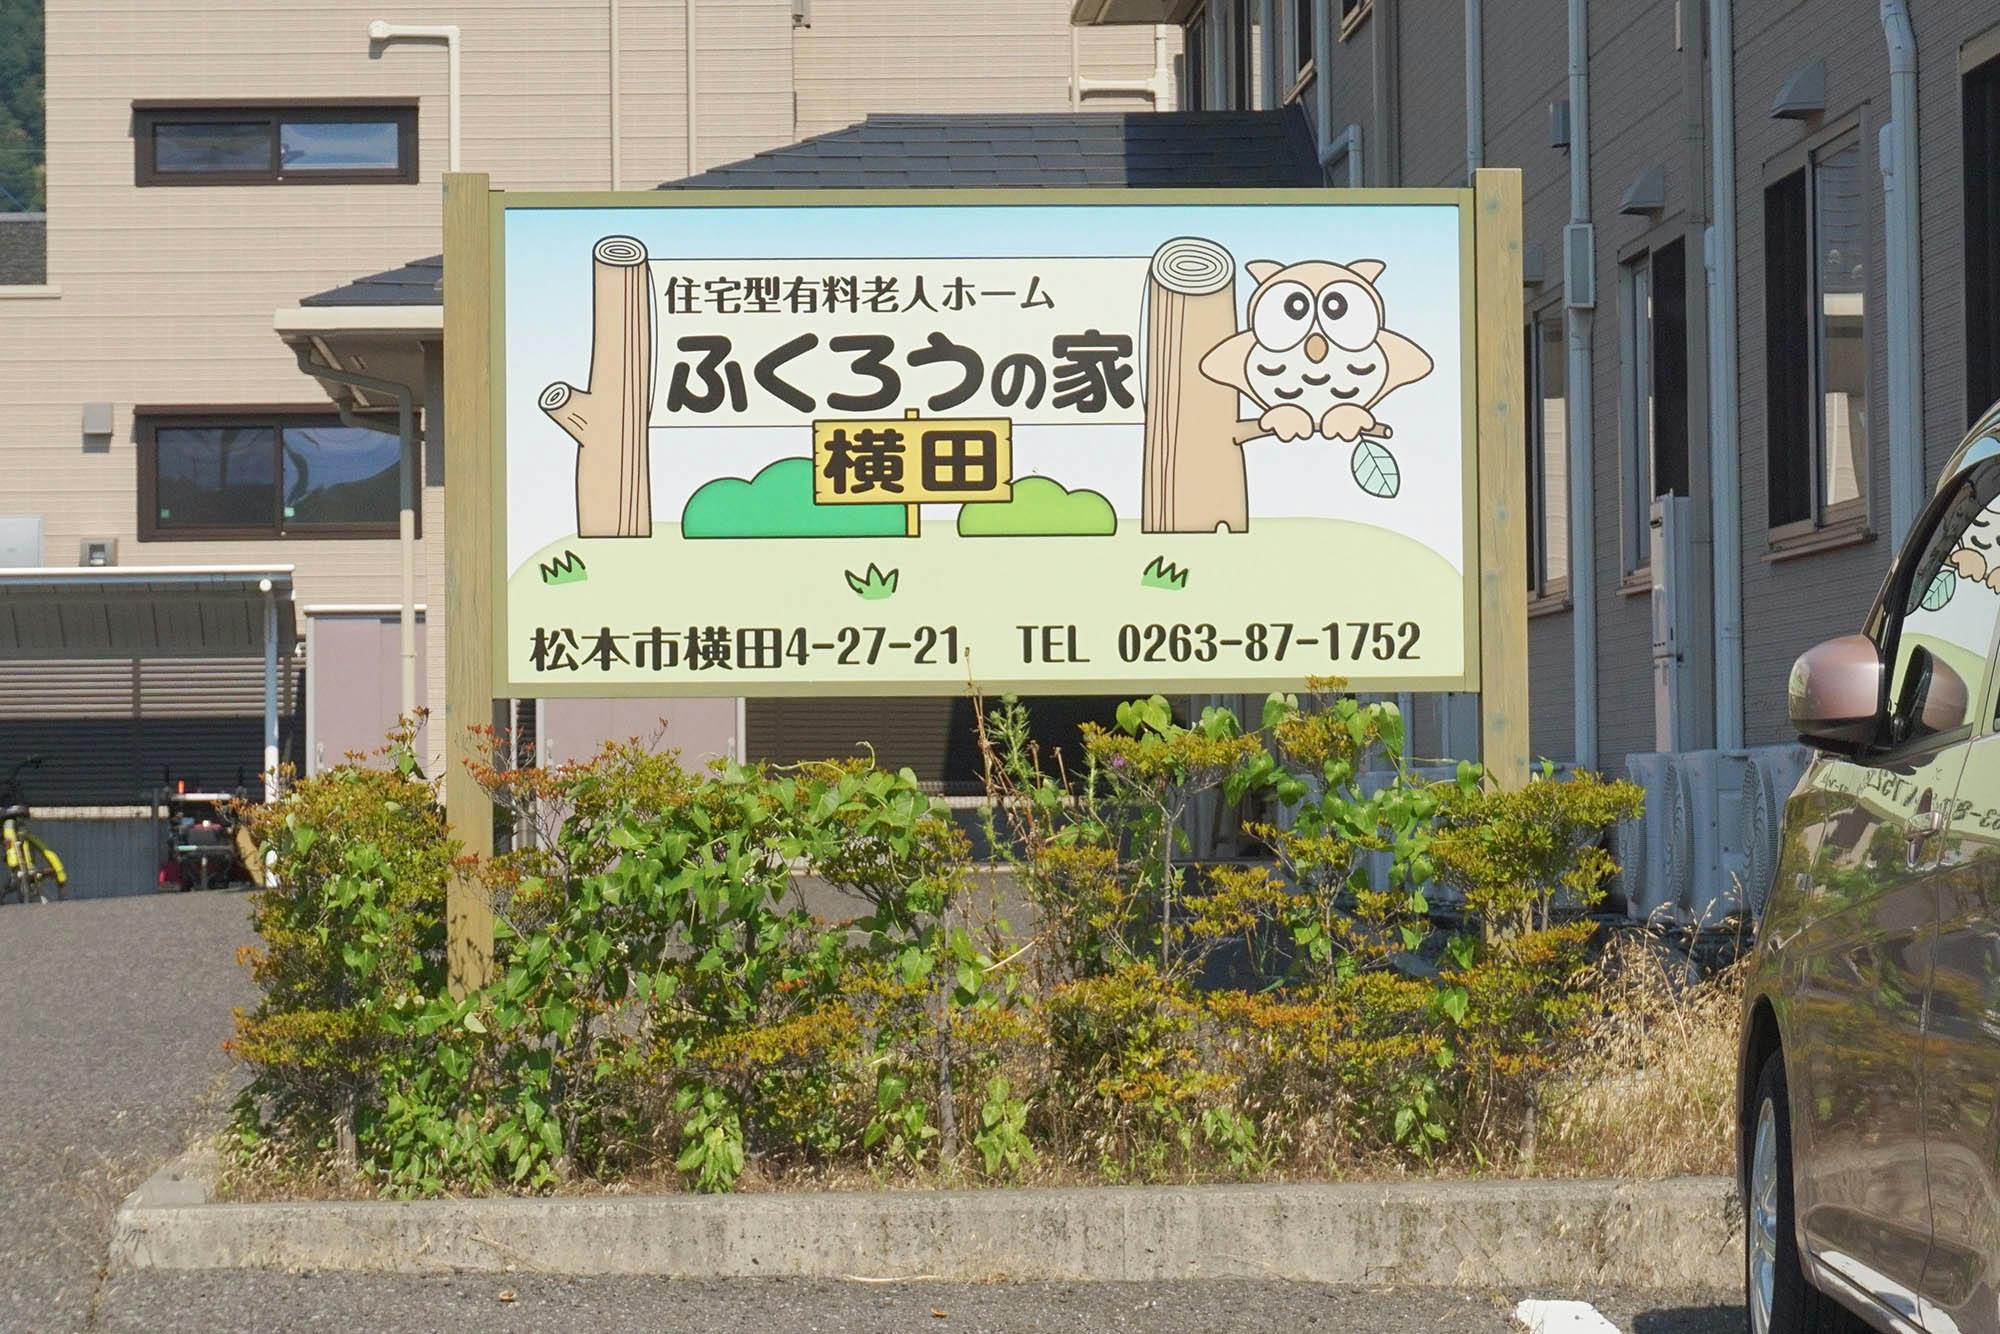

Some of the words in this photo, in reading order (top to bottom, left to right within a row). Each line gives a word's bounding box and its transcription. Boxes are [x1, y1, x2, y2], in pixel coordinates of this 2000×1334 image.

[664, 276, 1056, 314] 住宅型有料老人ホーム
[667, 329, 1135, 414] ふくろうの家
[823, 428, 998, 495] 横田
[1016, 624, 1090, 664] TEL
[1118, 621, 1421, 663] 0263-87-1752
